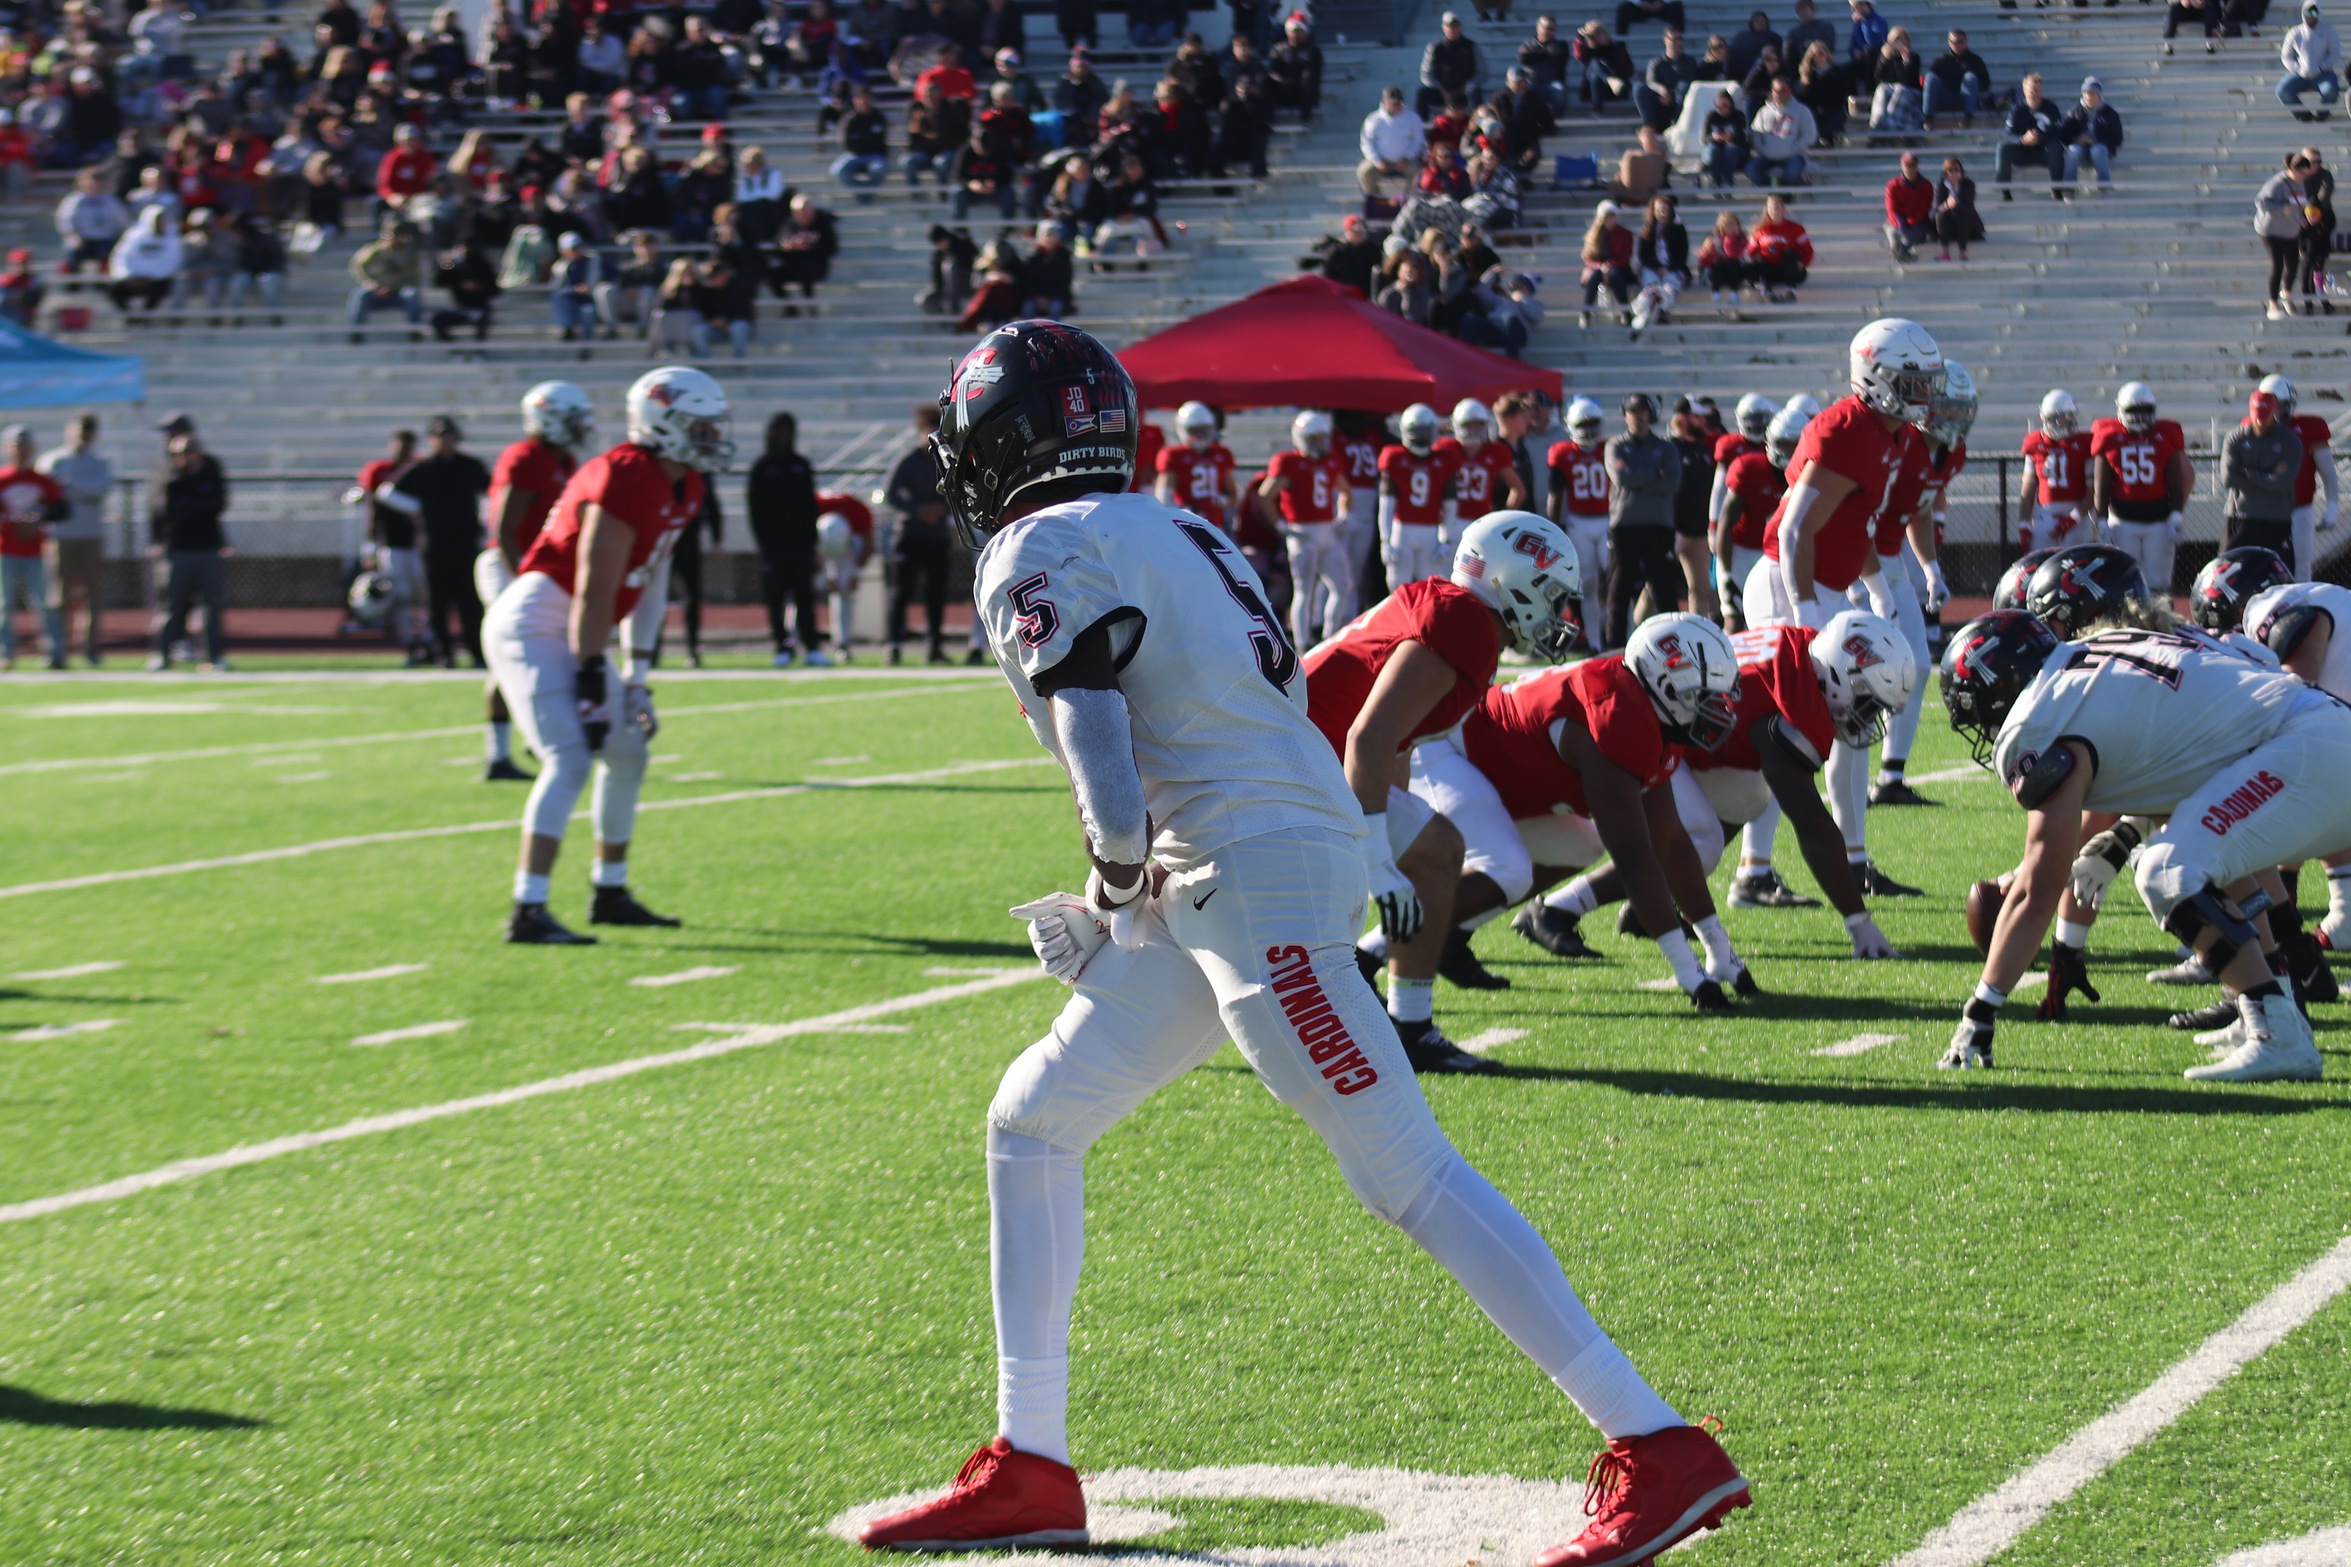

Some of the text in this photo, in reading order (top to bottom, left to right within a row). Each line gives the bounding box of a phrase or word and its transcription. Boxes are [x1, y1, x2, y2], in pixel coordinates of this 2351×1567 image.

[1067, 386, 1082, 400] JD
[1086, 368, 1095, 385] 5
[1069, 399, 1085, 413] 40
[1059, 446, 1126, 463] DIRTY BIRDS
[1345, 445, 1377, 477] 79
[2120, 445, 2156, 485] 55
[1190, 465, 1220, 502] 21
[1313, 471, 1330, 508] 6
[1409, 470, 1430, 507] 9
[1572, 463, 1607, 499] 20
[1513, 530, 1564, 571] GV
[1007, 571, 1060, 649] 5
[1655, 633, 1693, 671] GV
[1841, 633, 1885, 669] GV
[1266, 945, 1378, 1096] CARDINALS
